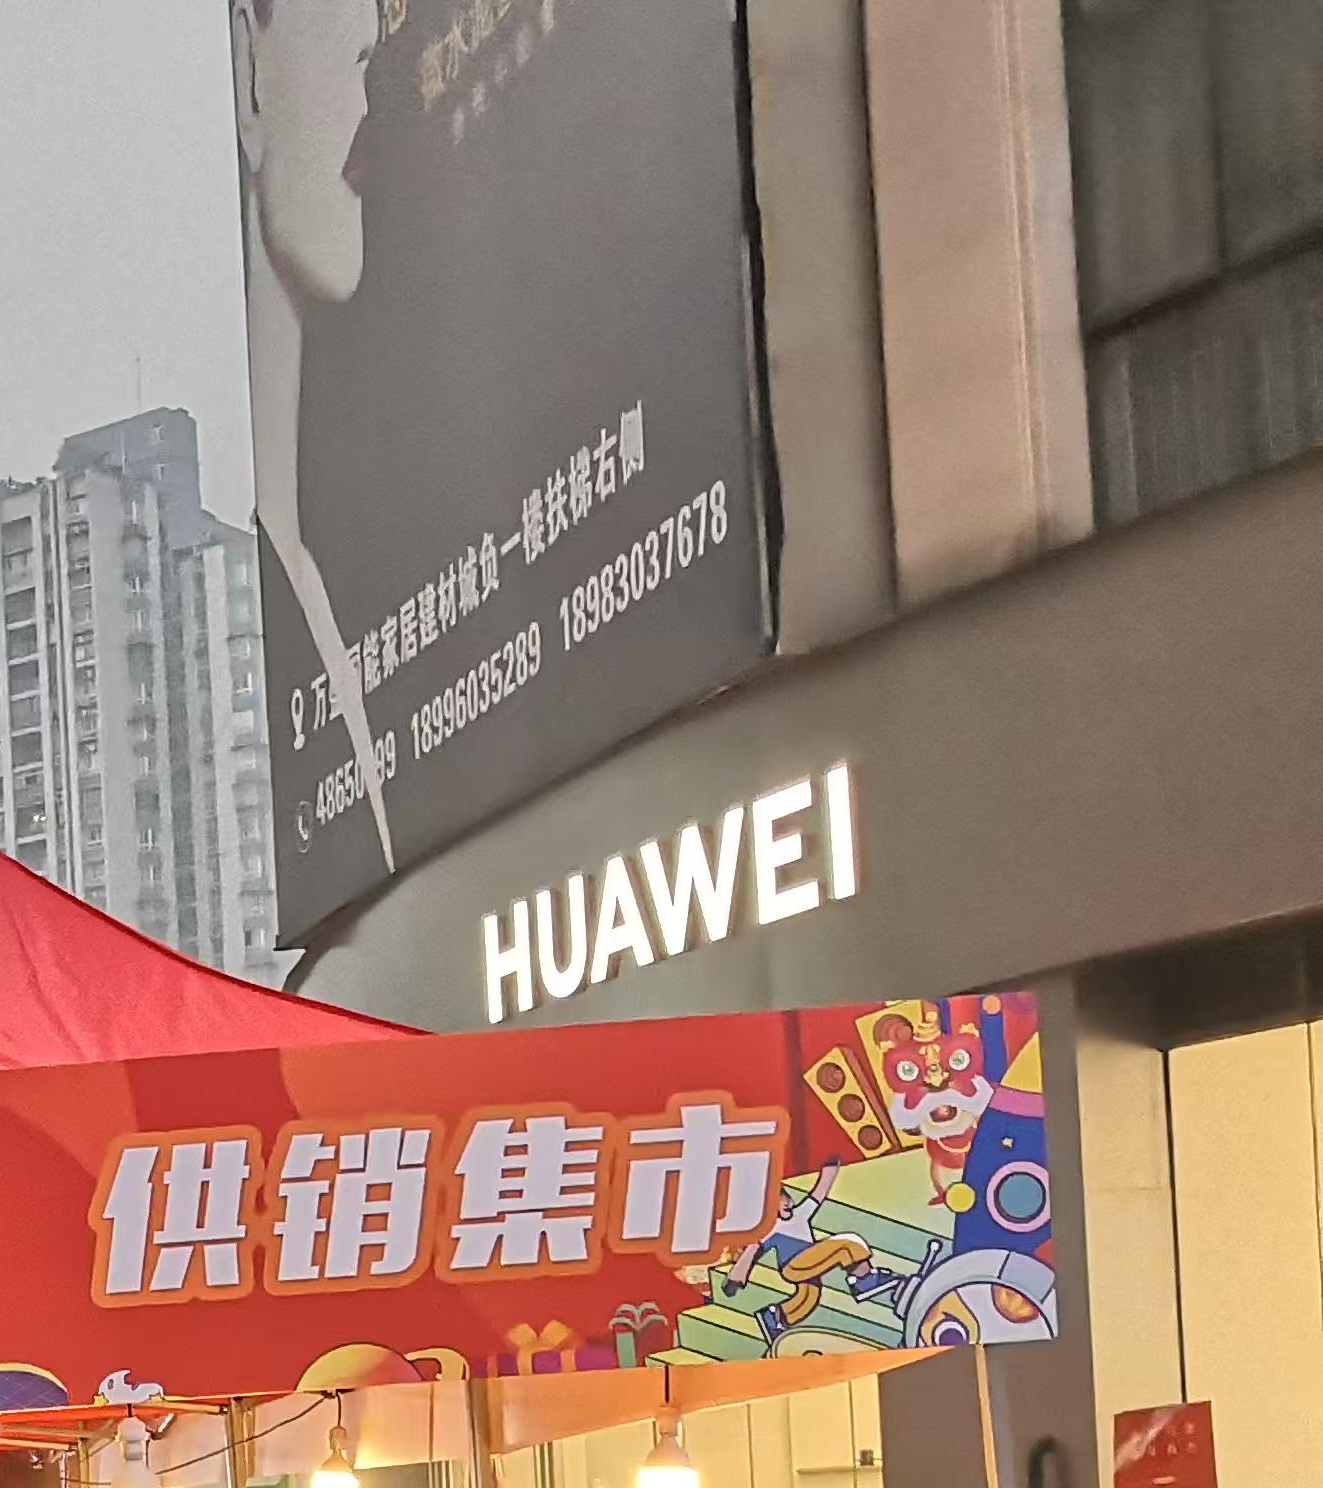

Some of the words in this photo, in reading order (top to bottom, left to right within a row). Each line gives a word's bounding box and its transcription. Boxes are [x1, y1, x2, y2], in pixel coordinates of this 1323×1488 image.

[411, 622, 541, 760] 18996035289
[560, 480, 727, 651] 18983037678
[482, 764, 856, 1025] HUAWEI
[103, 1104, 778, 1296] 供销集市
